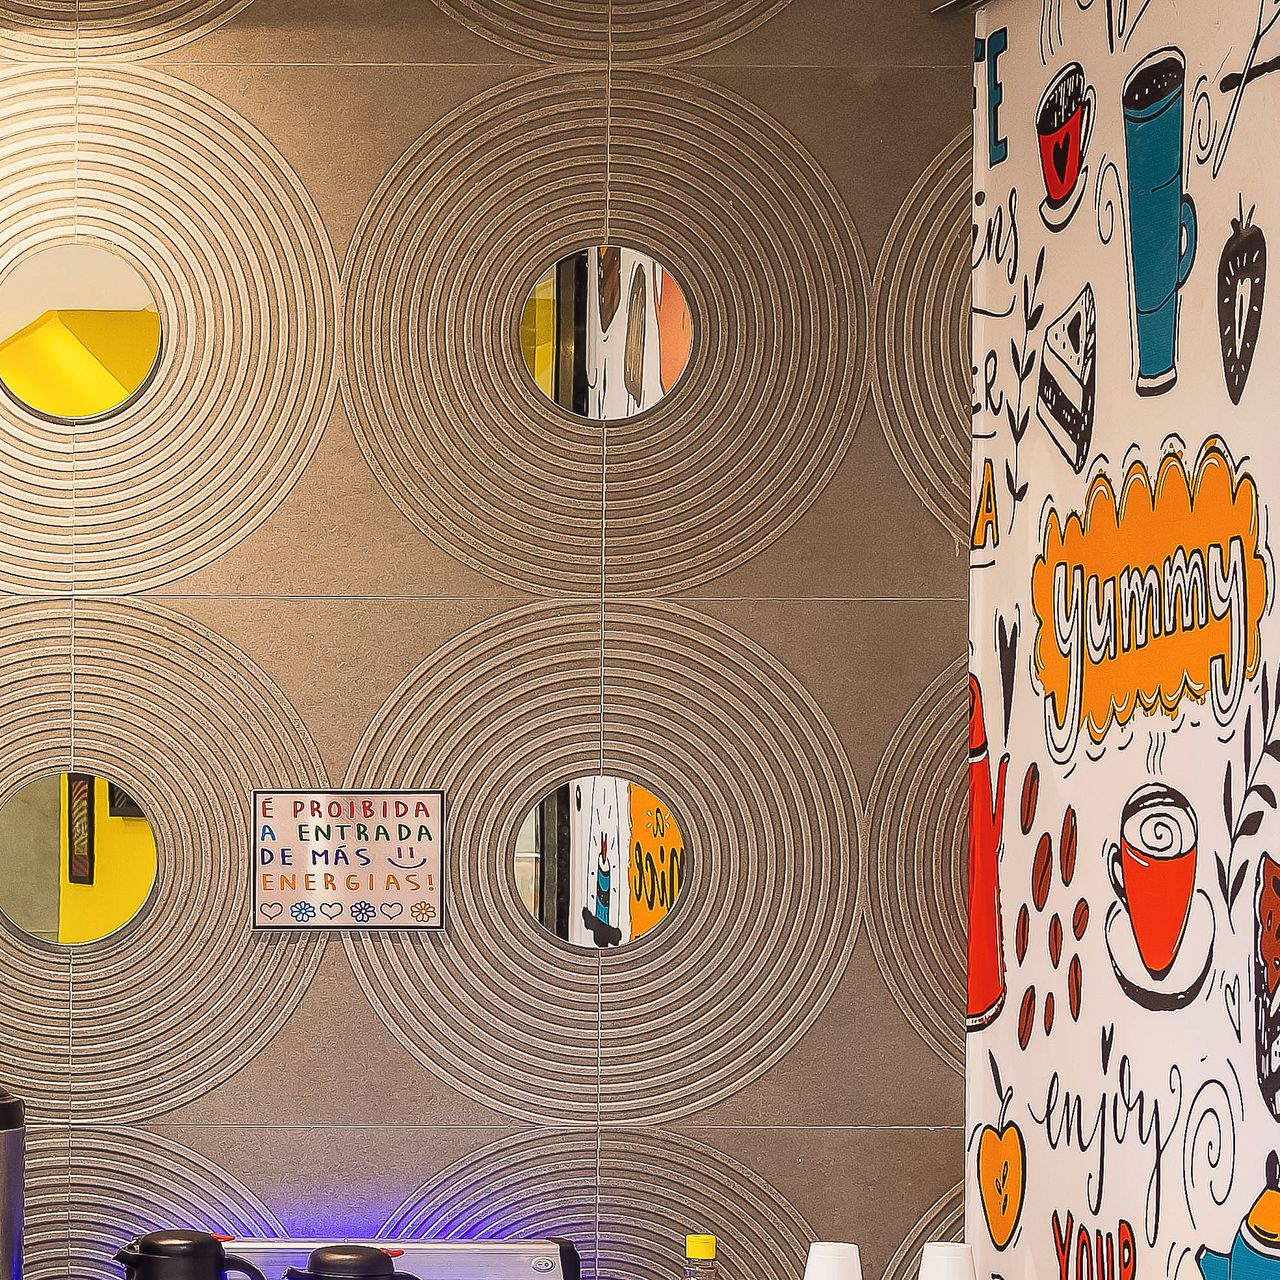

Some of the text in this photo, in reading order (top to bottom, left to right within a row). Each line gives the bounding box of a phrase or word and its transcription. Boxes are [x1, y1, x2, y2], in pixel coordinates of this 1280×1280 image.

[1044, 535, 1248, 765] yummy
[262, 797, 430, 818] É PROIBIDA
[261, 824, 432, 841] A ENTRADA
[261, 845, 371, 866] DE MÁS
[262, 873, 434, 891] ENERGIAS!
[1027, 1054, 1183, 1248] enjoy
